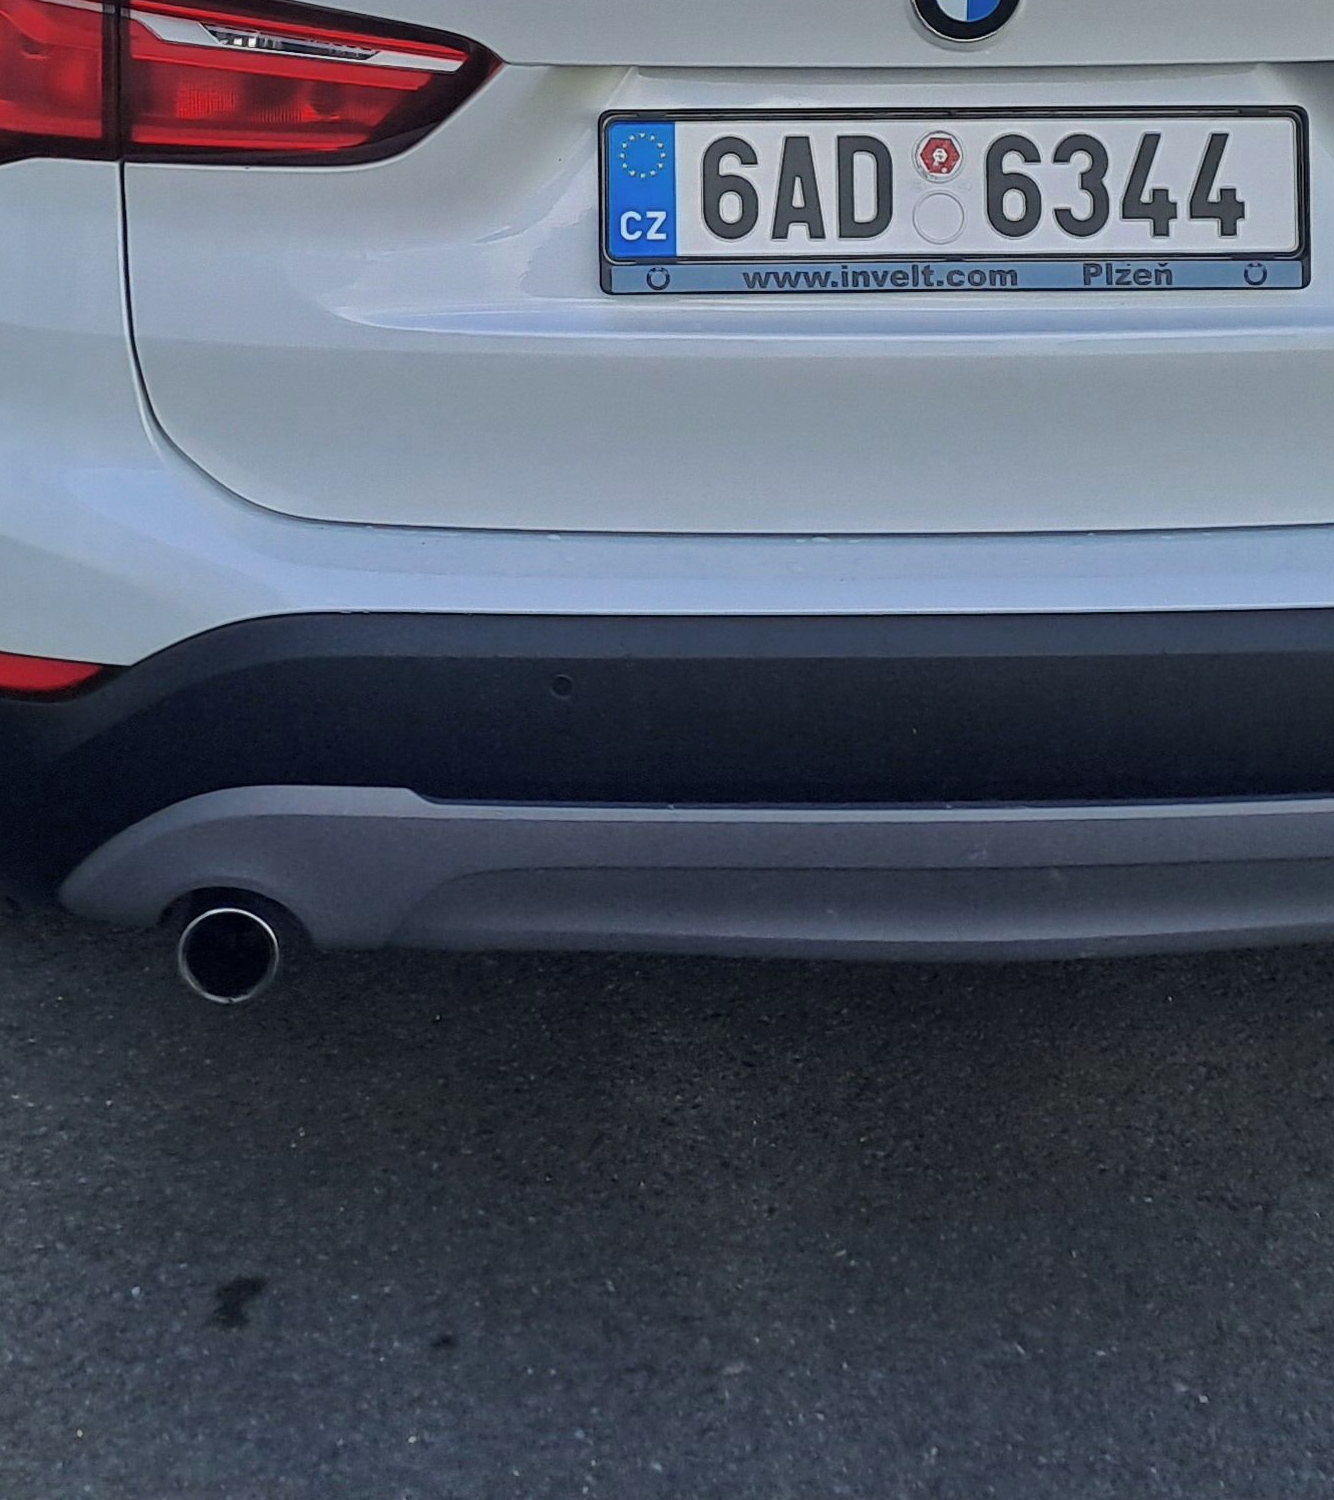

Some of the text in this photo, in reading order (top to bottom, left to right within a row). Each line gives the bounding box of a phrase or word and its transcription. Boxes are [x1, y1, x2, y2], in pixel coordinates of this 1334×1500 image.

[701, 133, 1246, 240] 6AD 6344
[619, 210, 668, 242] CZ
[742, 262, 1173, 289] www.invelt.com Plzeň
